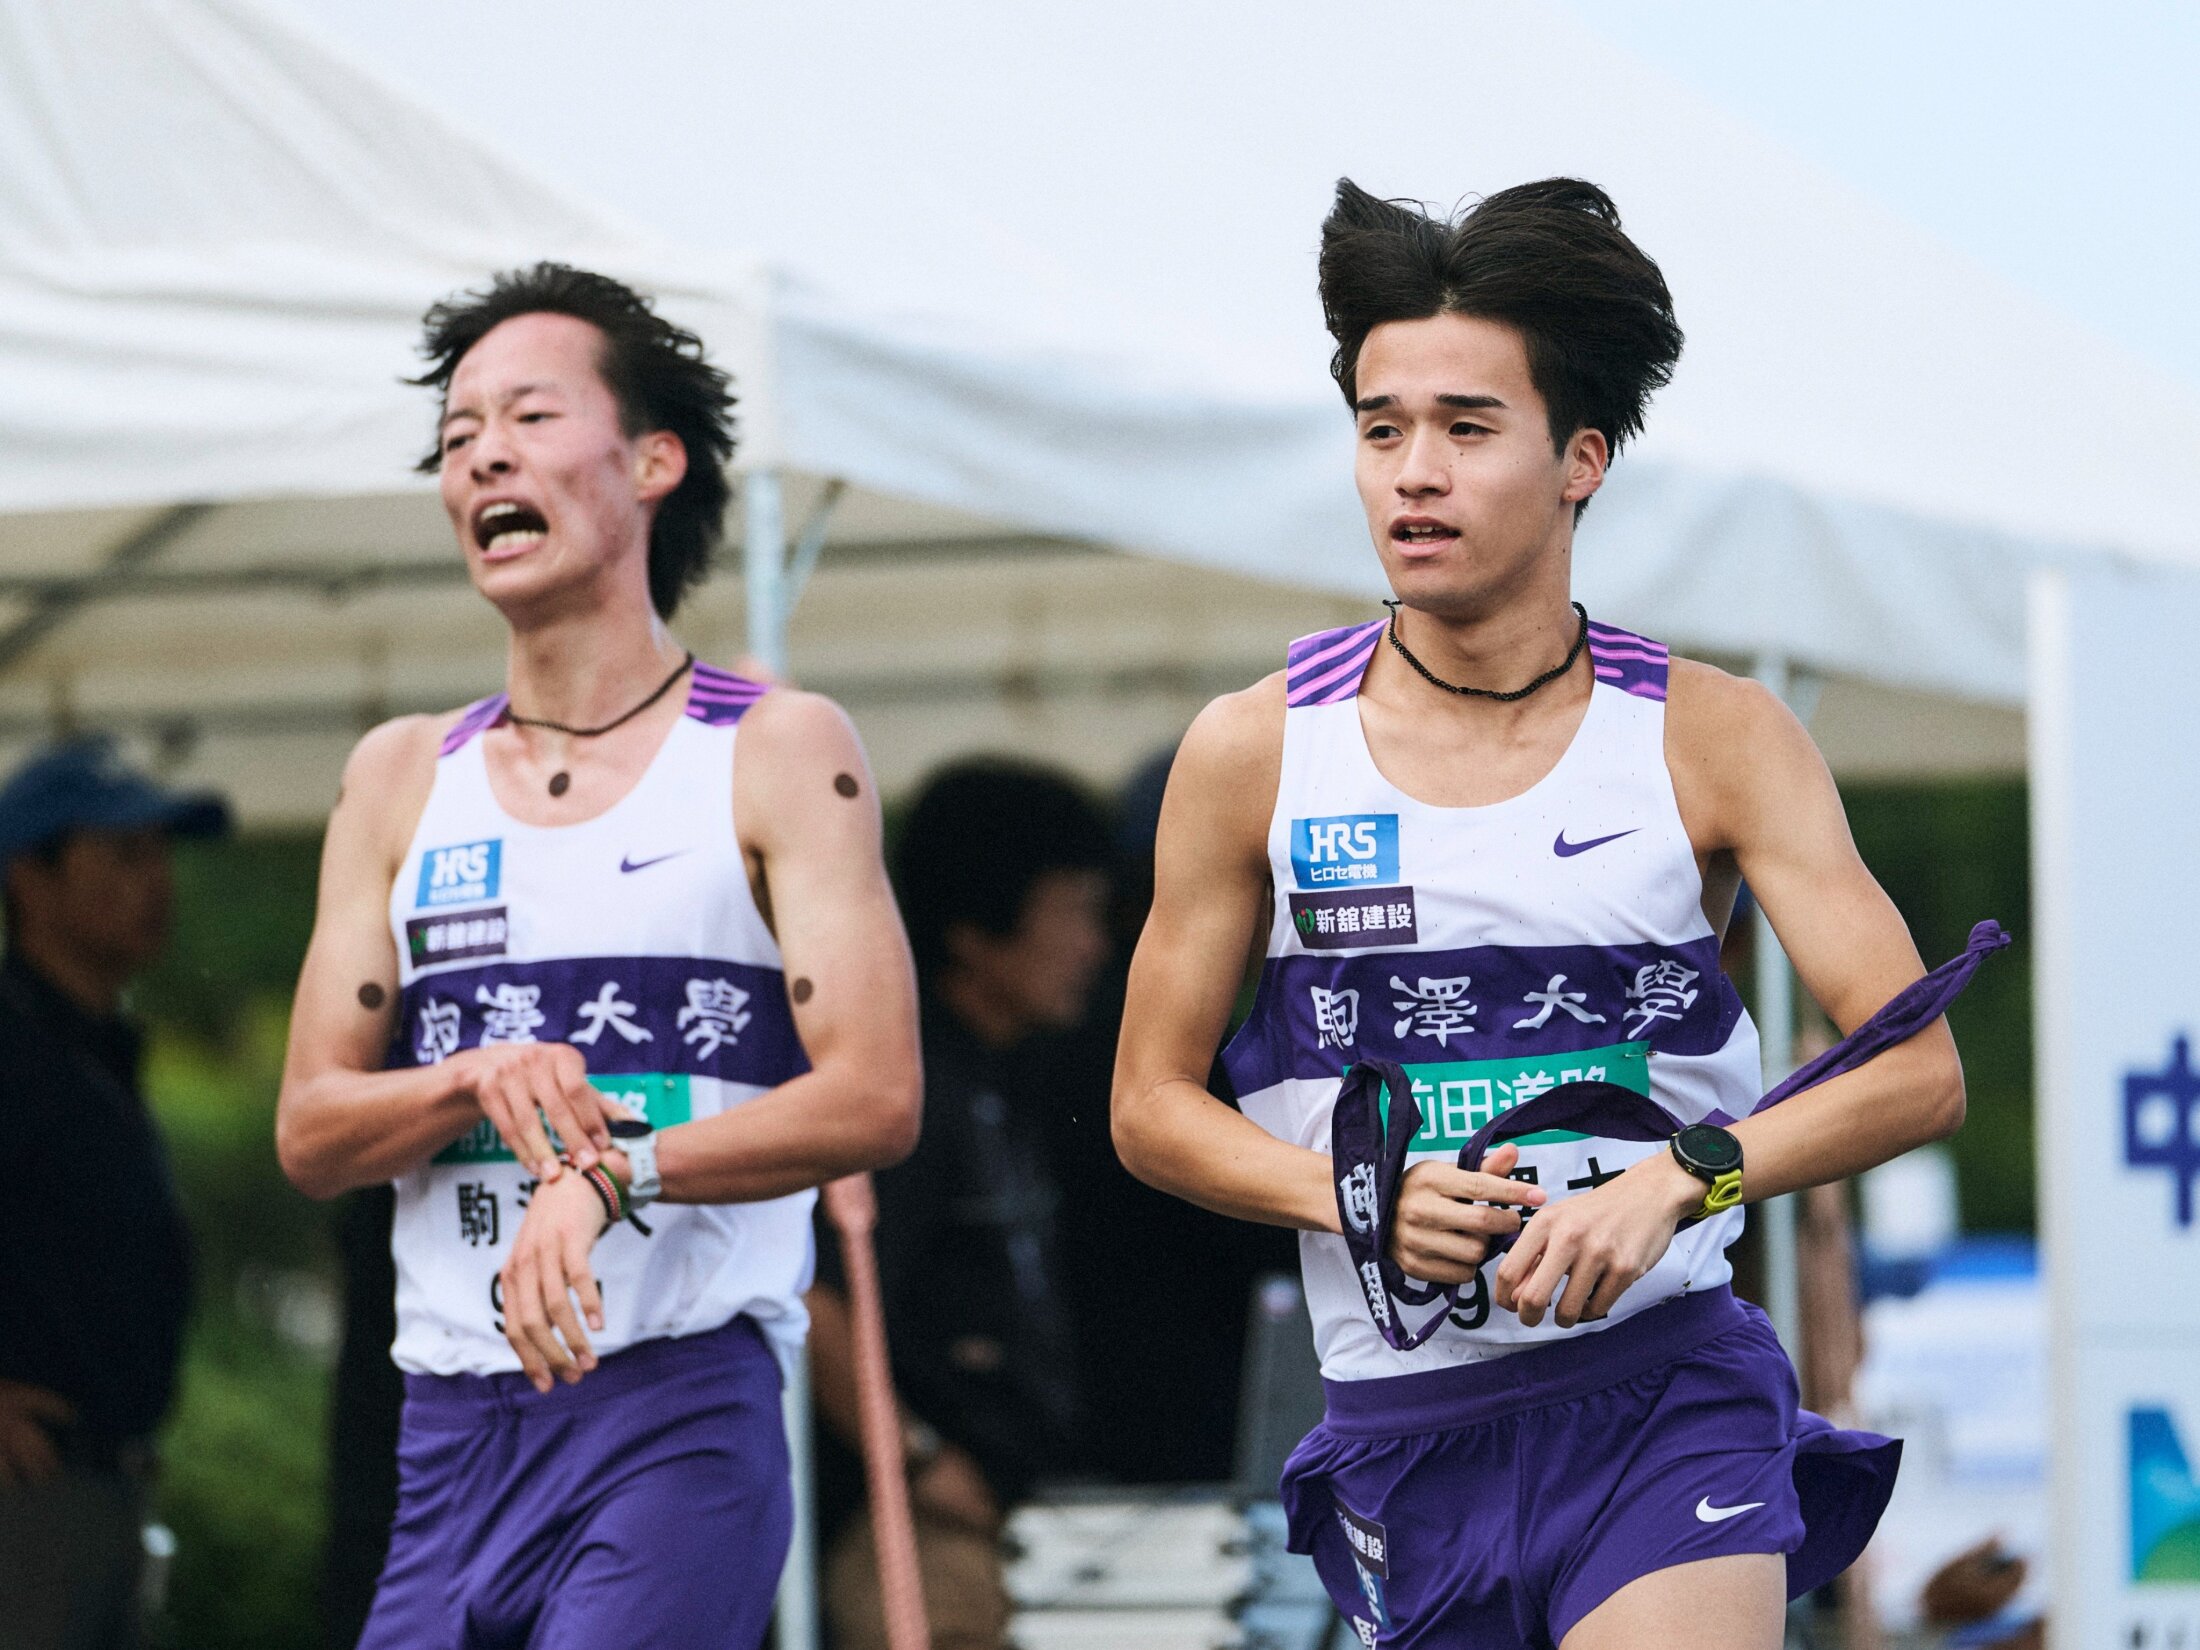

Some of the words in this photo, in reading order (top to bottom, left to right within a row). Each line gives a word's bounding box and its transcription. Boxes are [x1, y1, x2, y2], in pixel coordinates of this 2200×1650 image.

[1309, 821, 1377, 863] HRS
[429, 843, 490, 889] HRS
[1310, 863, 1378, 882] ヒロセ電機
